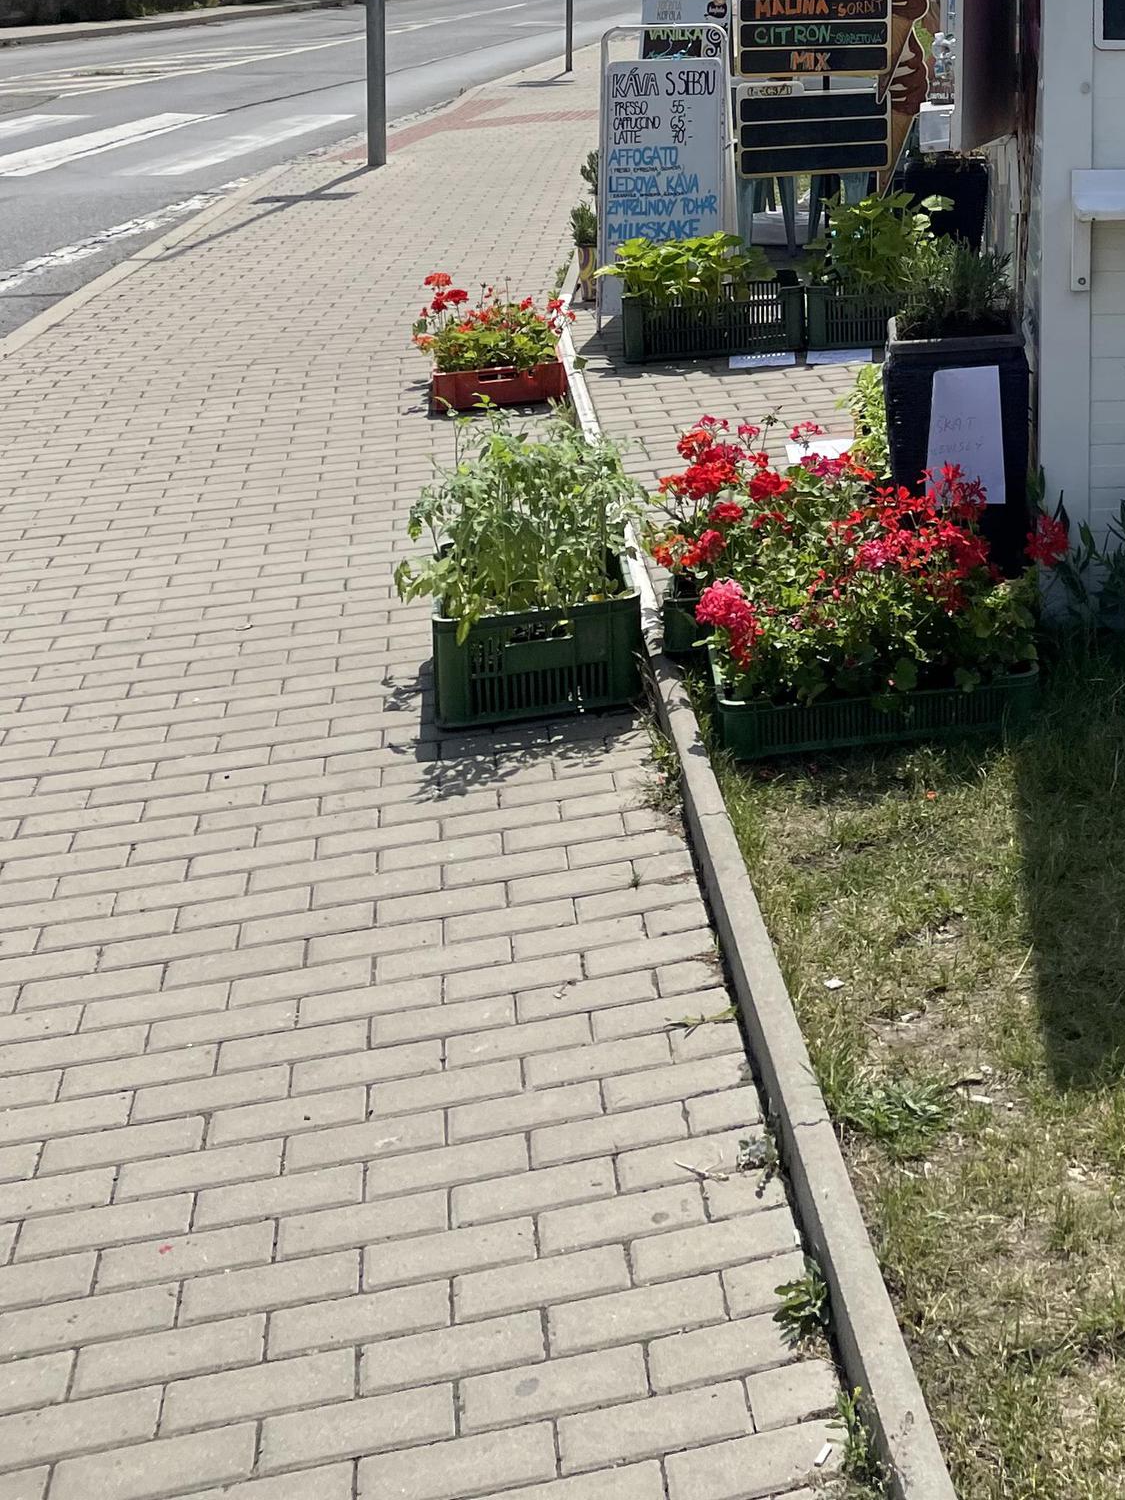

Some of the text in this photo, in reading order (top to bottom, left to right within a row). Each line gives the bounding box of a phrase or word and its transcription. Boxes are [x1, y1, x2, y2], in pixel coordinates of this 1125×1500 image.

[790, 50, 832, 71] MIX
[612, 67, 660, 99] KÁVA
[614, 100, 649, 117] PRESSO
[613, 130, 642, 145] LATTE
[607, 146, 679, 168] AFFOGATO
